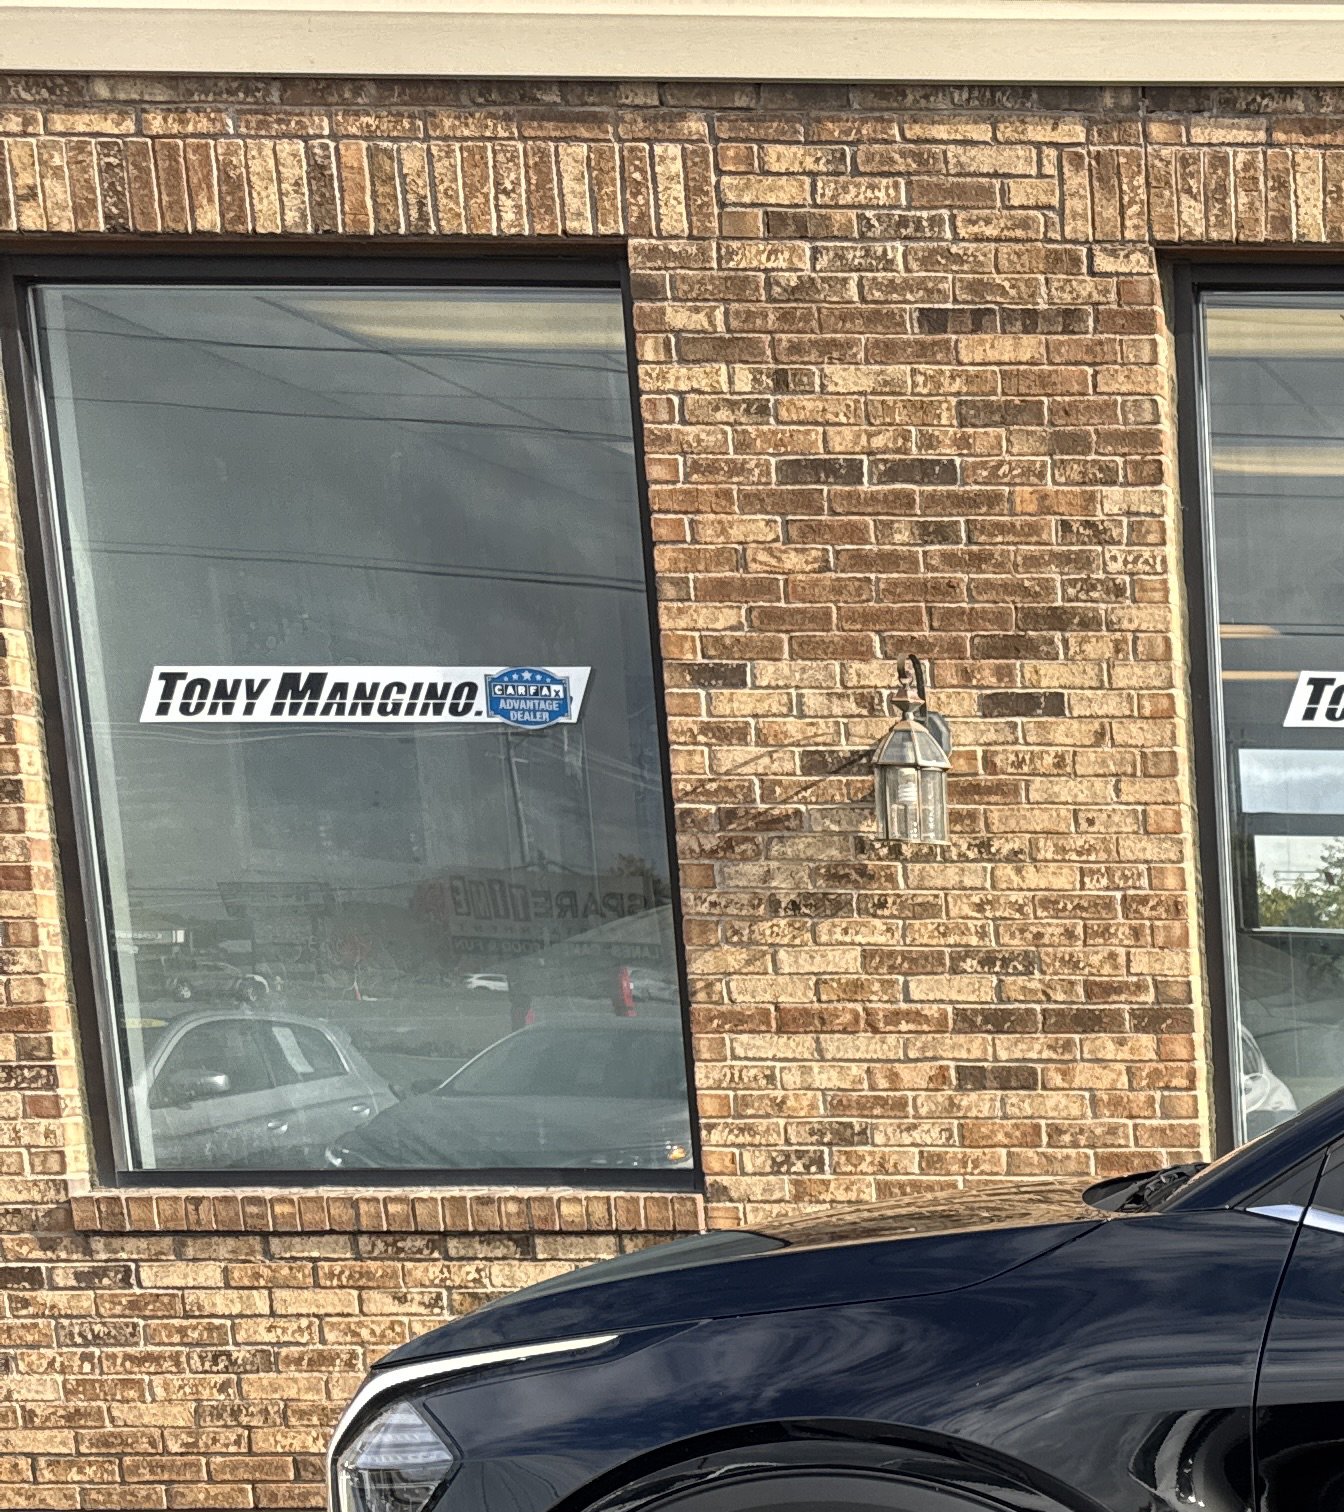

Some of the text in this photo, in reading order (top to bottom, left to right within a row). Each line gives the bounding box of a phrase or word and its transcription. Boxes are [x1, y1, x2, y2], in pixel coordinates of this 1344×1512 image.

[156, 672, 271, 717] TONY
[492, 684, 563, 699] CARFAX
[499, 700, 561, 712] ADVANTAGE
[510, 711, 550, 722] DEALER
